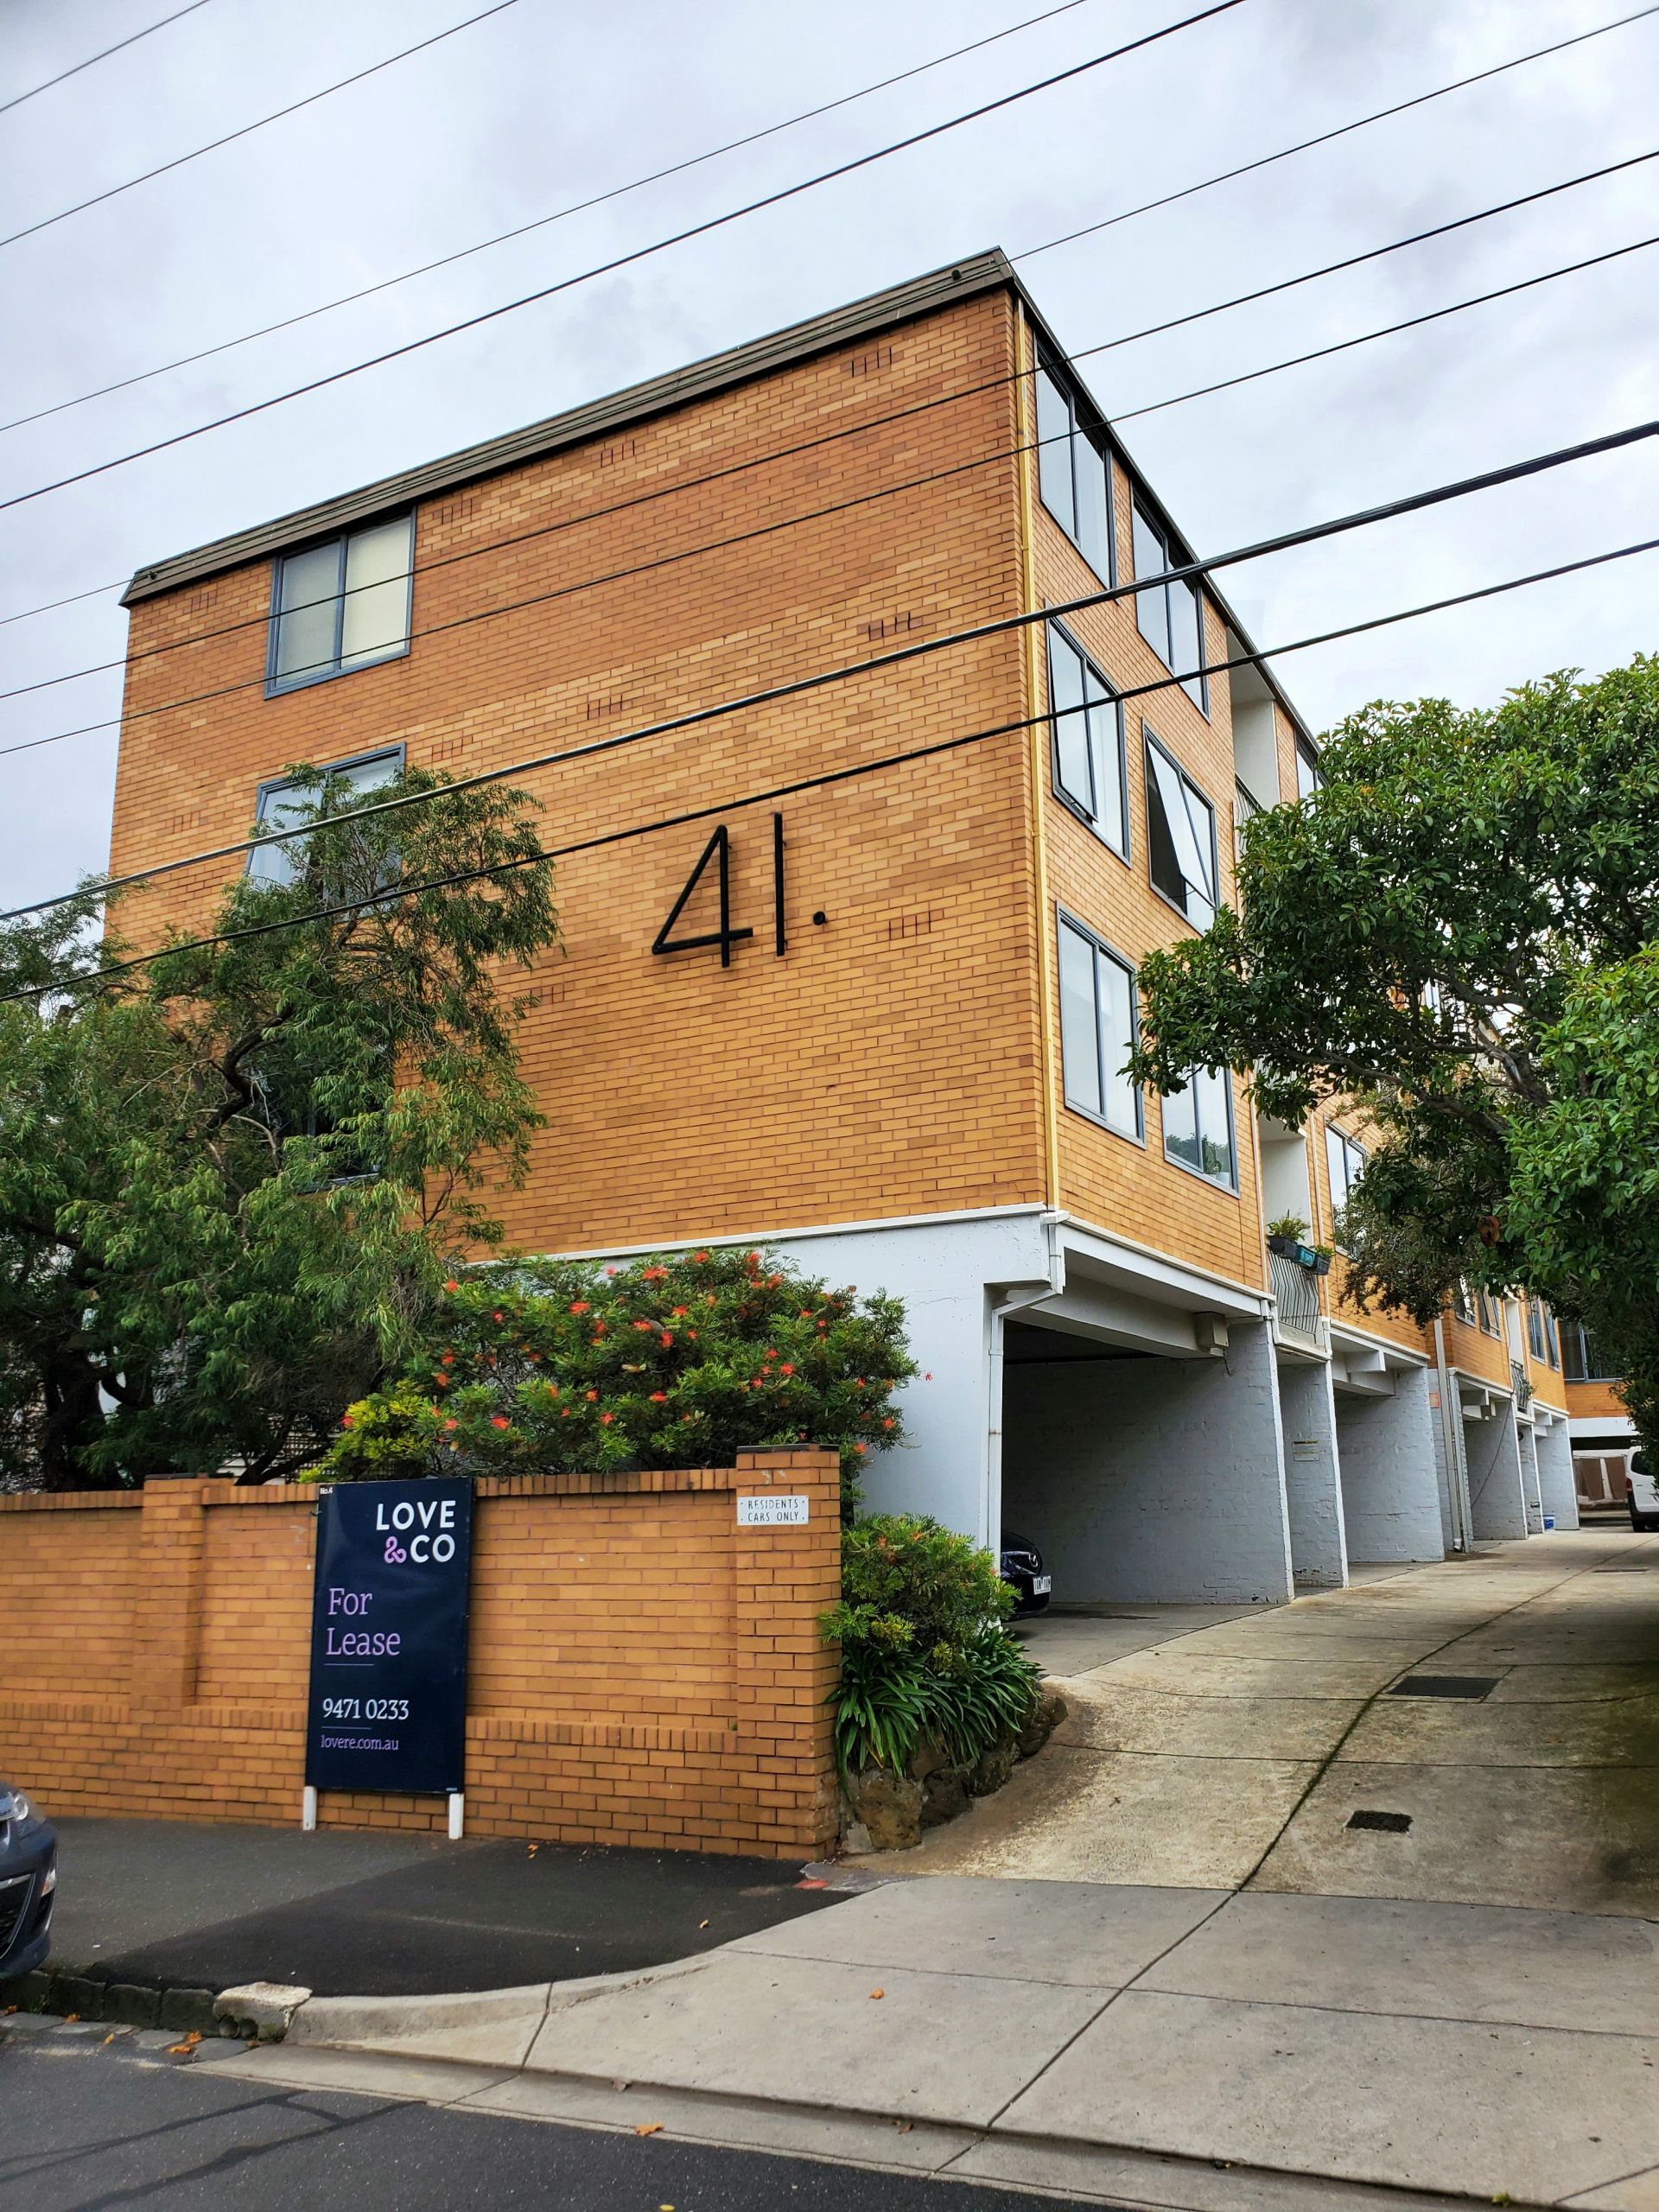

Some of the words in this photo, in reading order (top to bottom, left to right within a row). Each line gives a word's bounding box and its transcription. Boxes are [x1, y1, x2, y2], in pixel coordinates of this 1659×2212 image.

[747, 1498, 798, 1510] RESIDENTS
[376, 1500, 456, 1531] LOVE
[747, 1511, 770, 1522] CARS
[776, 1511, 799, 1522] ONLY
[327, 1587, 373, 1616] For
[326, 1627, 401, 1656] Lease
[322, 1698, 361, 1719] 9471
[365, 1699, 410, 1720] 0233
[321, 1734, 399, 1751] lovere.com.au
